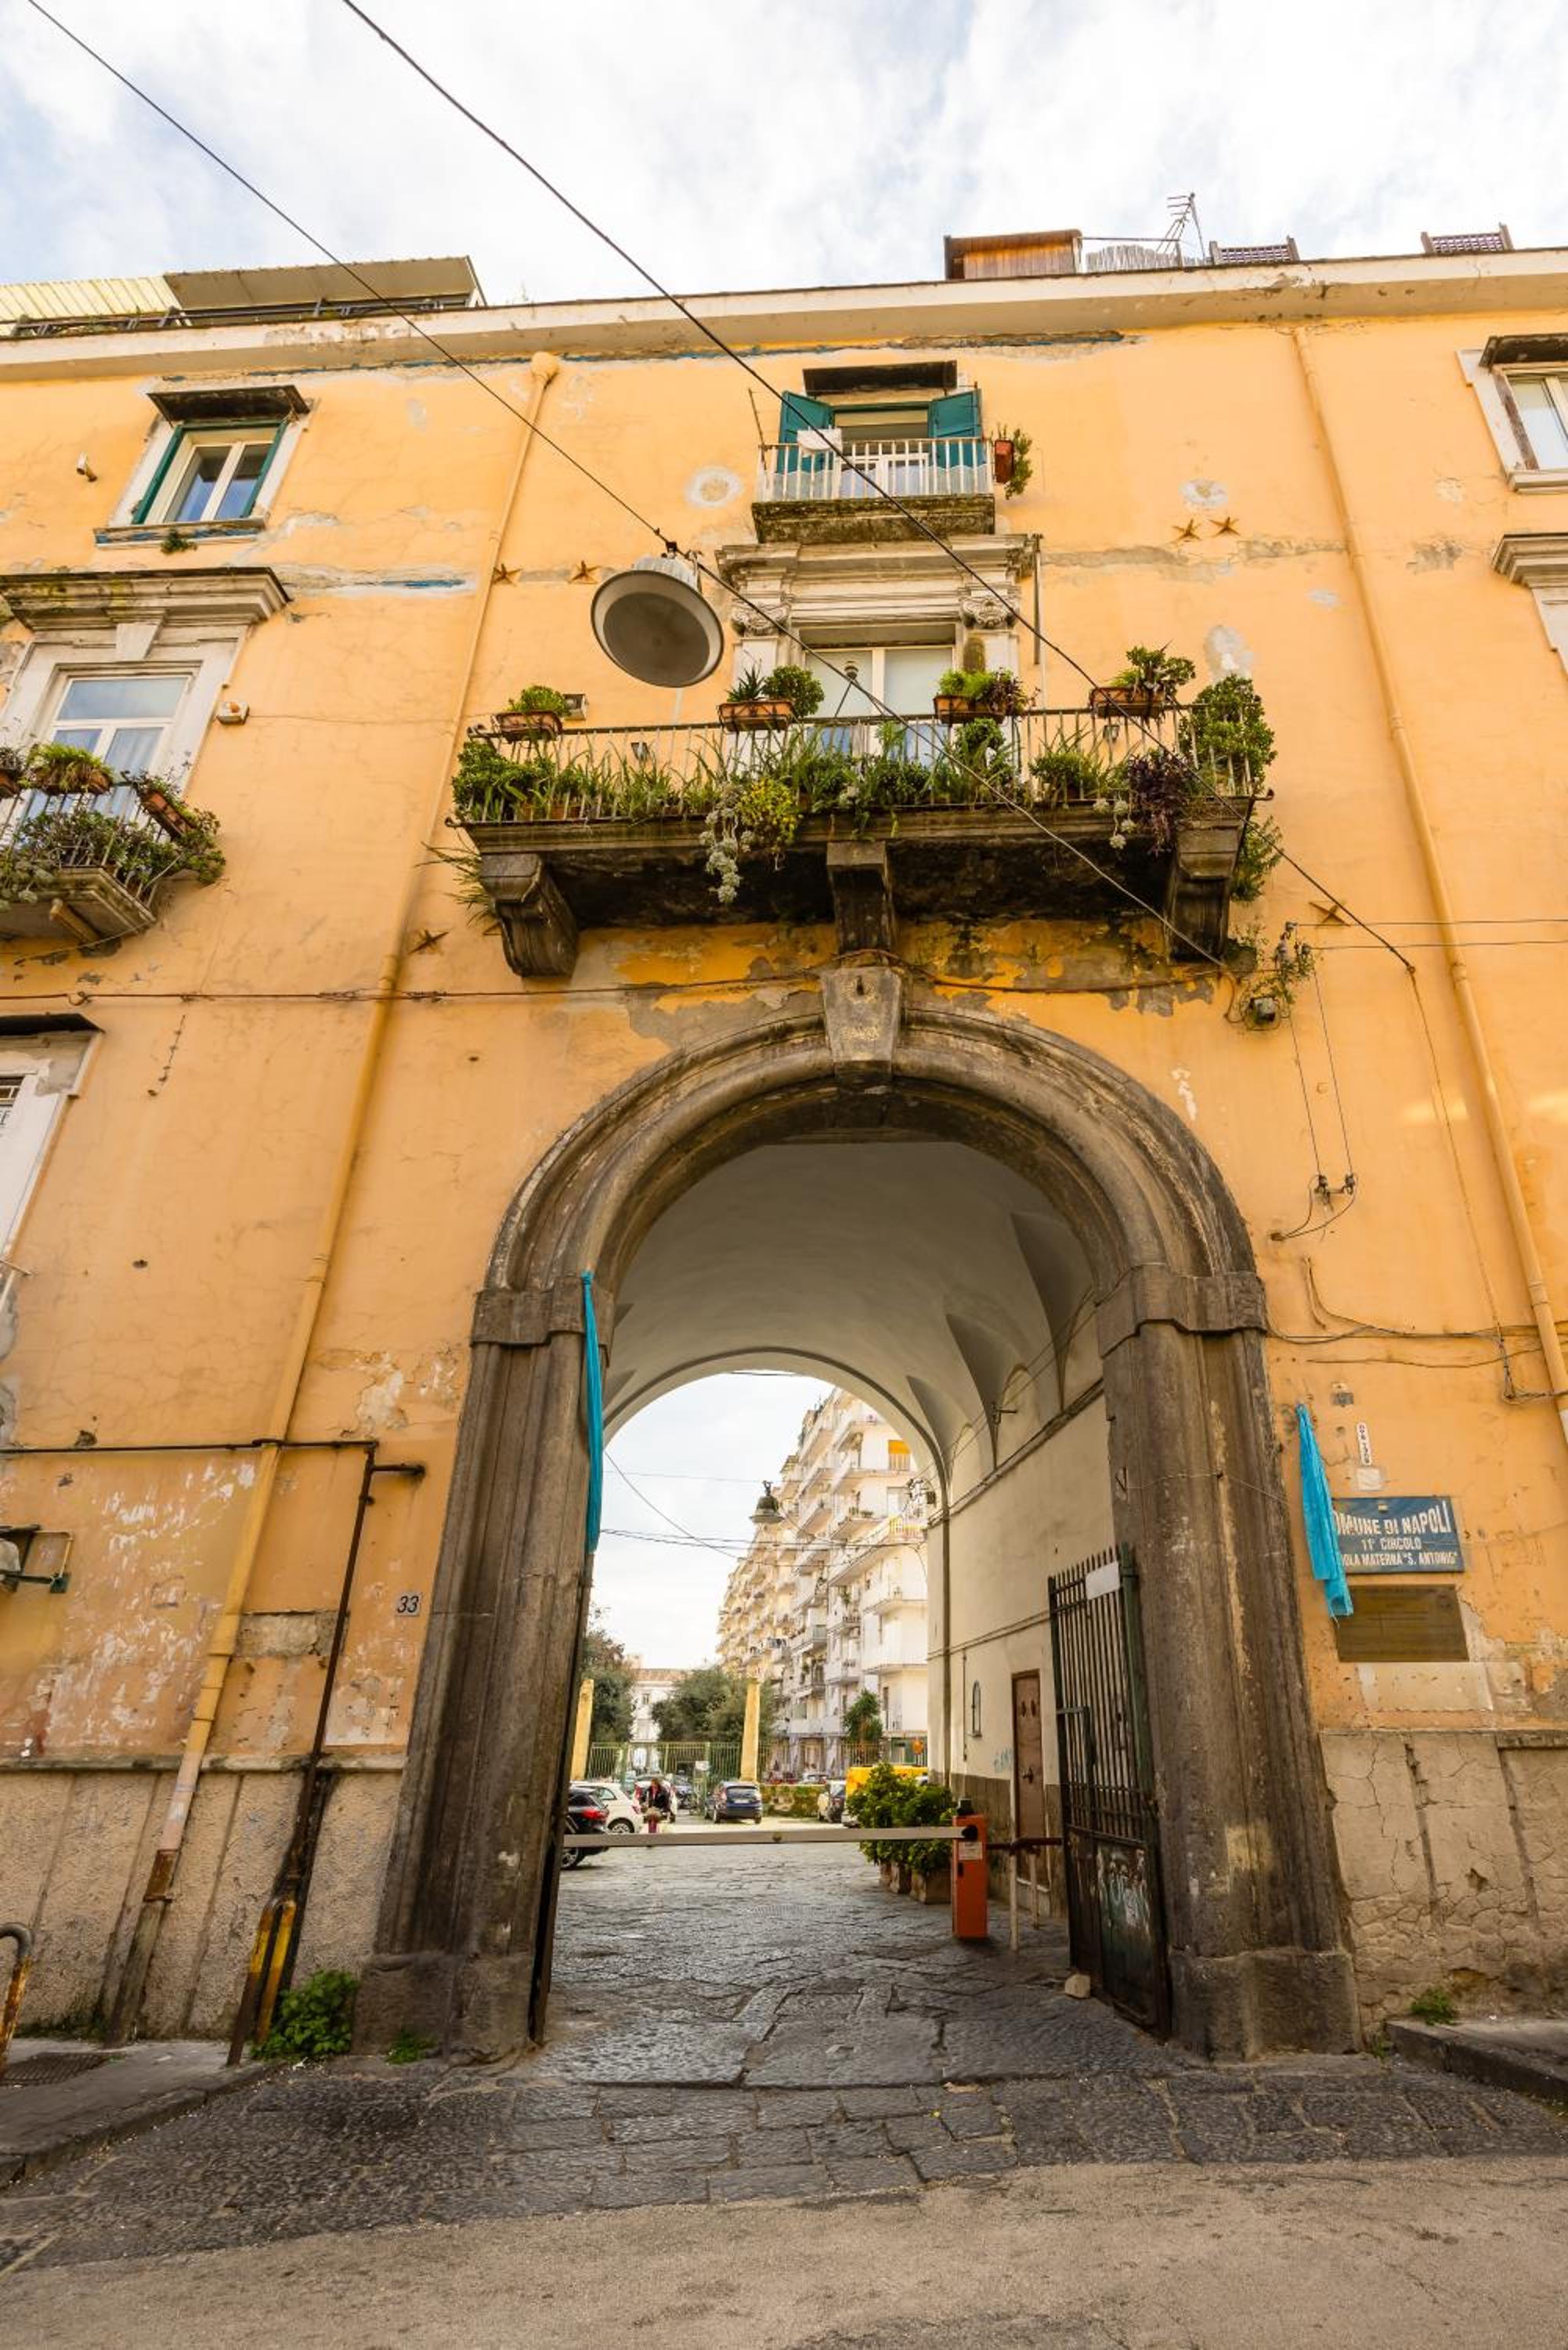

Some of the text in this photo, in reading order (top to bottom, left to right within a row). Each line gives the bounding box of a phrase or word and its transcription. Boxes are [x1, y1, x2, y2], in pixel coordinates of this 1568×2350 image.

[1333, 1509, 1382, 1536] OMUNE
[1402, 1500, 1451, 1535] NAPOLI
[1380, 1537, 1422, 1550] CIRCOLO
[1342, 1553, 1361, 1566] OLA
[1361, 1553, 1402, 1566] MATERNA
[397, 1596, 419, 1613] 33
